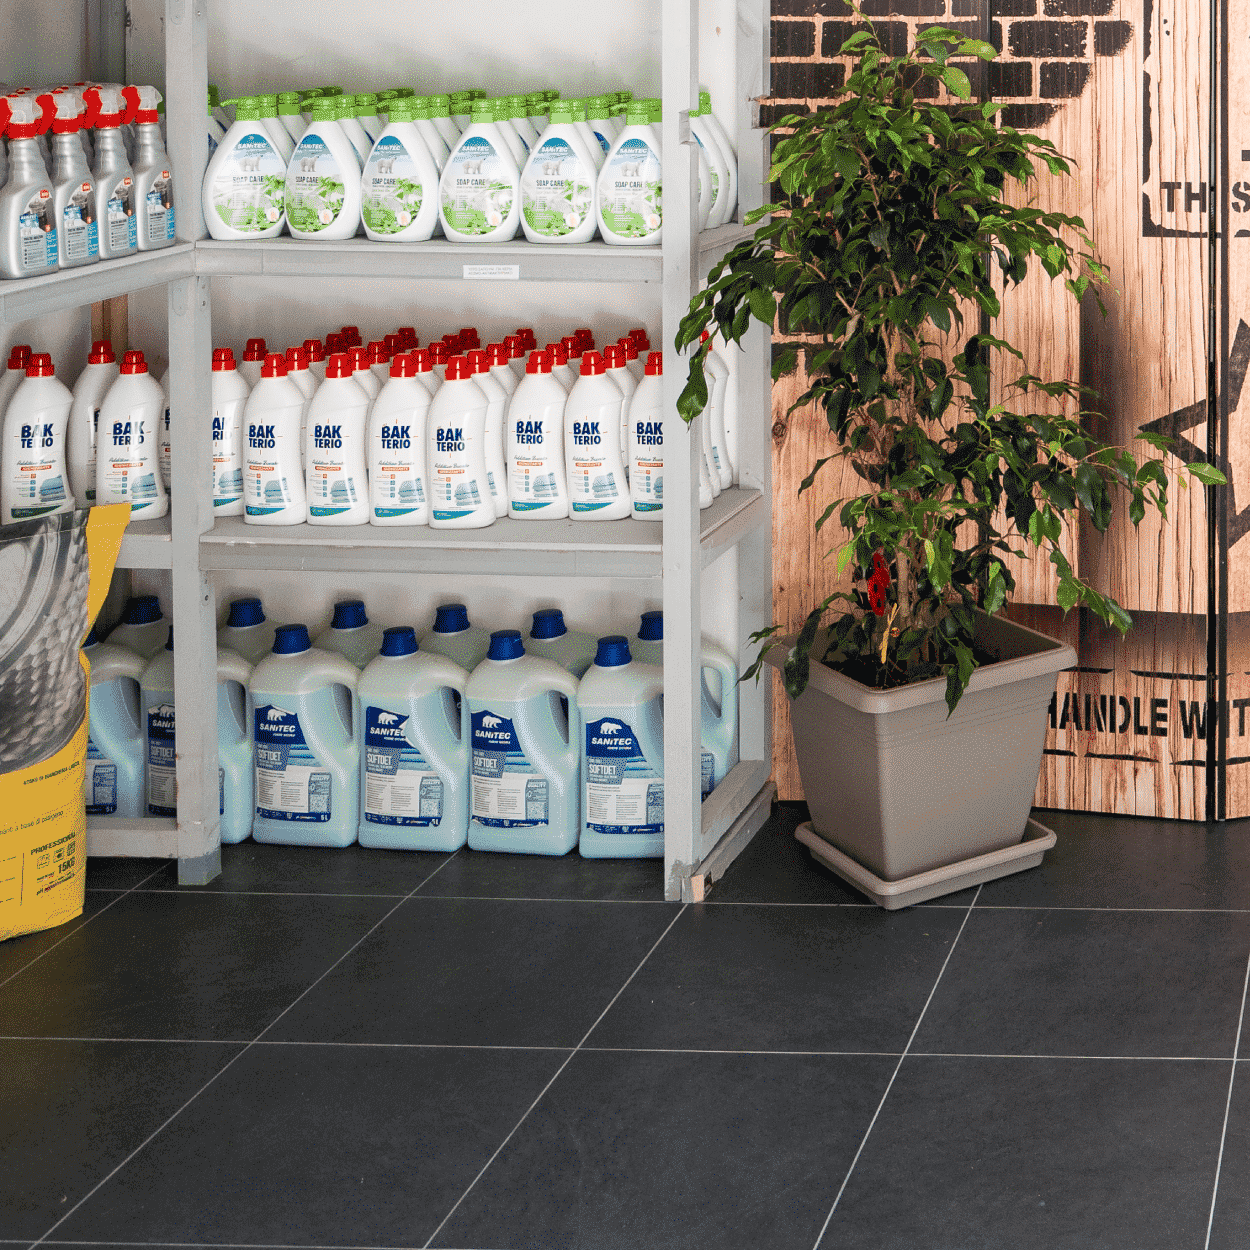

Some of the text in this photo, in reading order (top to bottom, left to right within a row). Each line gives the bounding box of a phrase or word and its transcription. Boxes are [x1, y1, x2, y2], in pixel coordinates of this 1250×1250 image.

[295, 176, 318, 184] SOAP CARE
[456, 178, 486, 186] SOAP CARE
[615, 180, 643, 188] SOAP CARE
[21, 423, 54, 438] BAK
[112, 421, 144, 435] BAK
[249, 425, 275, 438] BAK
[314, 425, 342, 438] BAK
[381, 425, 410, 438] BAK
[516, 421, 543, 434] BAK
[573, 422, 600, 434] BAK
[636, 422, 663, 435] BAK
[436, 428, 464, 441] BAK
[516, 434, 544, 444] TERIO
[574, 435, 601, 445] TERIO
[636, 435, 663, 445] TERIO
[249, 438, 276, 448] TERIO
[314, 438, 342, 449] TERIO
[382, 439, 411, 449] TERIO
[436, 442, 465, 452] TERIO
[258, 749, 281, 761] SOFTDET
[367, 754, 392, 766] SOFTDET
[474, 757, 497, 769] SOFTDET
[589, 764, 616, 775] SOFTDET
[58, 856, 75, 874] 15KG
